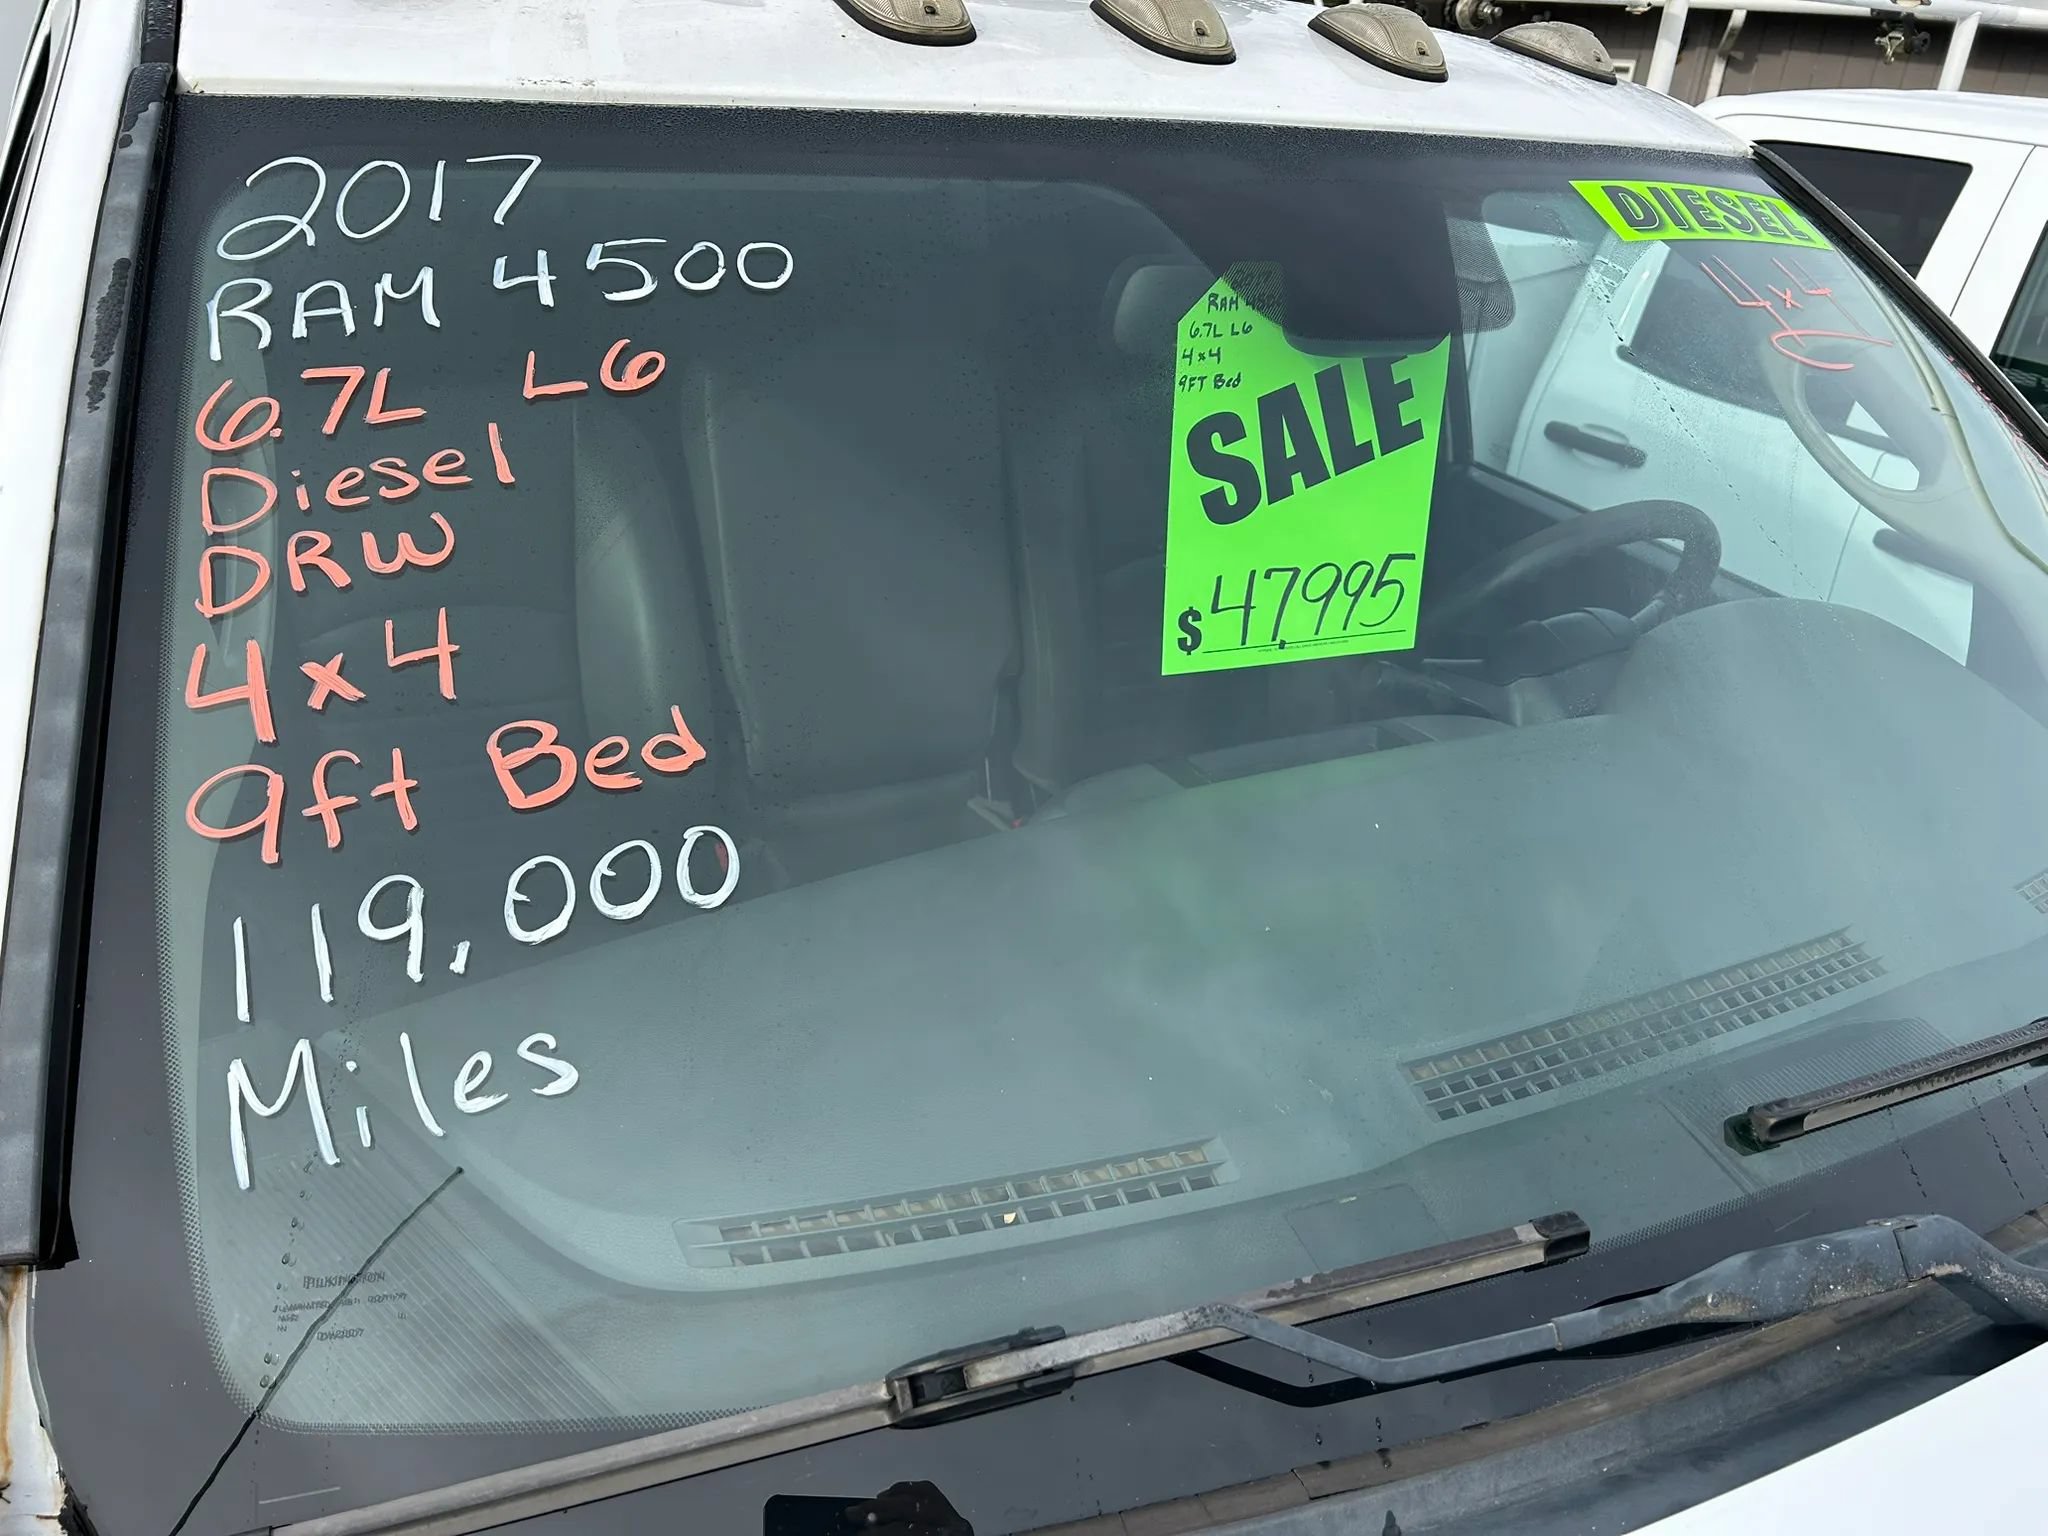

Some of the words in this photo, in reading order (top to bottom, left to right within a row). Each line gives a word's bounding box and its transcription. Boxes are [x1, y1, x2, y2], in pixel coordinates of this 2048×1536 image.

[217, 155, 542, 260] 2017
[1601, 185, 1815, 240] DIESEL
[207, 266, 440, 362] RAM
[493, 238, 794, 307] 4500
[1189, 321, 1223, 338] 6.7L
[1230, 321, 1253, 336] L6
[1208, 292, 1239, 314] RAM
[1700, 255, 1873, 347] 4x4
[195, 366, 427, 451] 6.7L
[523, 339, 666, 399] L6
[1178, 374, 1207, 392] 9FT
[1213, 372, 1241, 390] Bed
[1182, 347, 1221, 366] 4x4
[200, 422, 515, 535] Diesel
[1186, 355, 1425, 525] SALE
[195, 512, 455, 618] DRW
[185, 607, 460, 742] 4x4
[186, 747, 417, 863] 9ft
[486, 705, 706, 810] Bed
[227, 1032, 579, 1189] Miles
